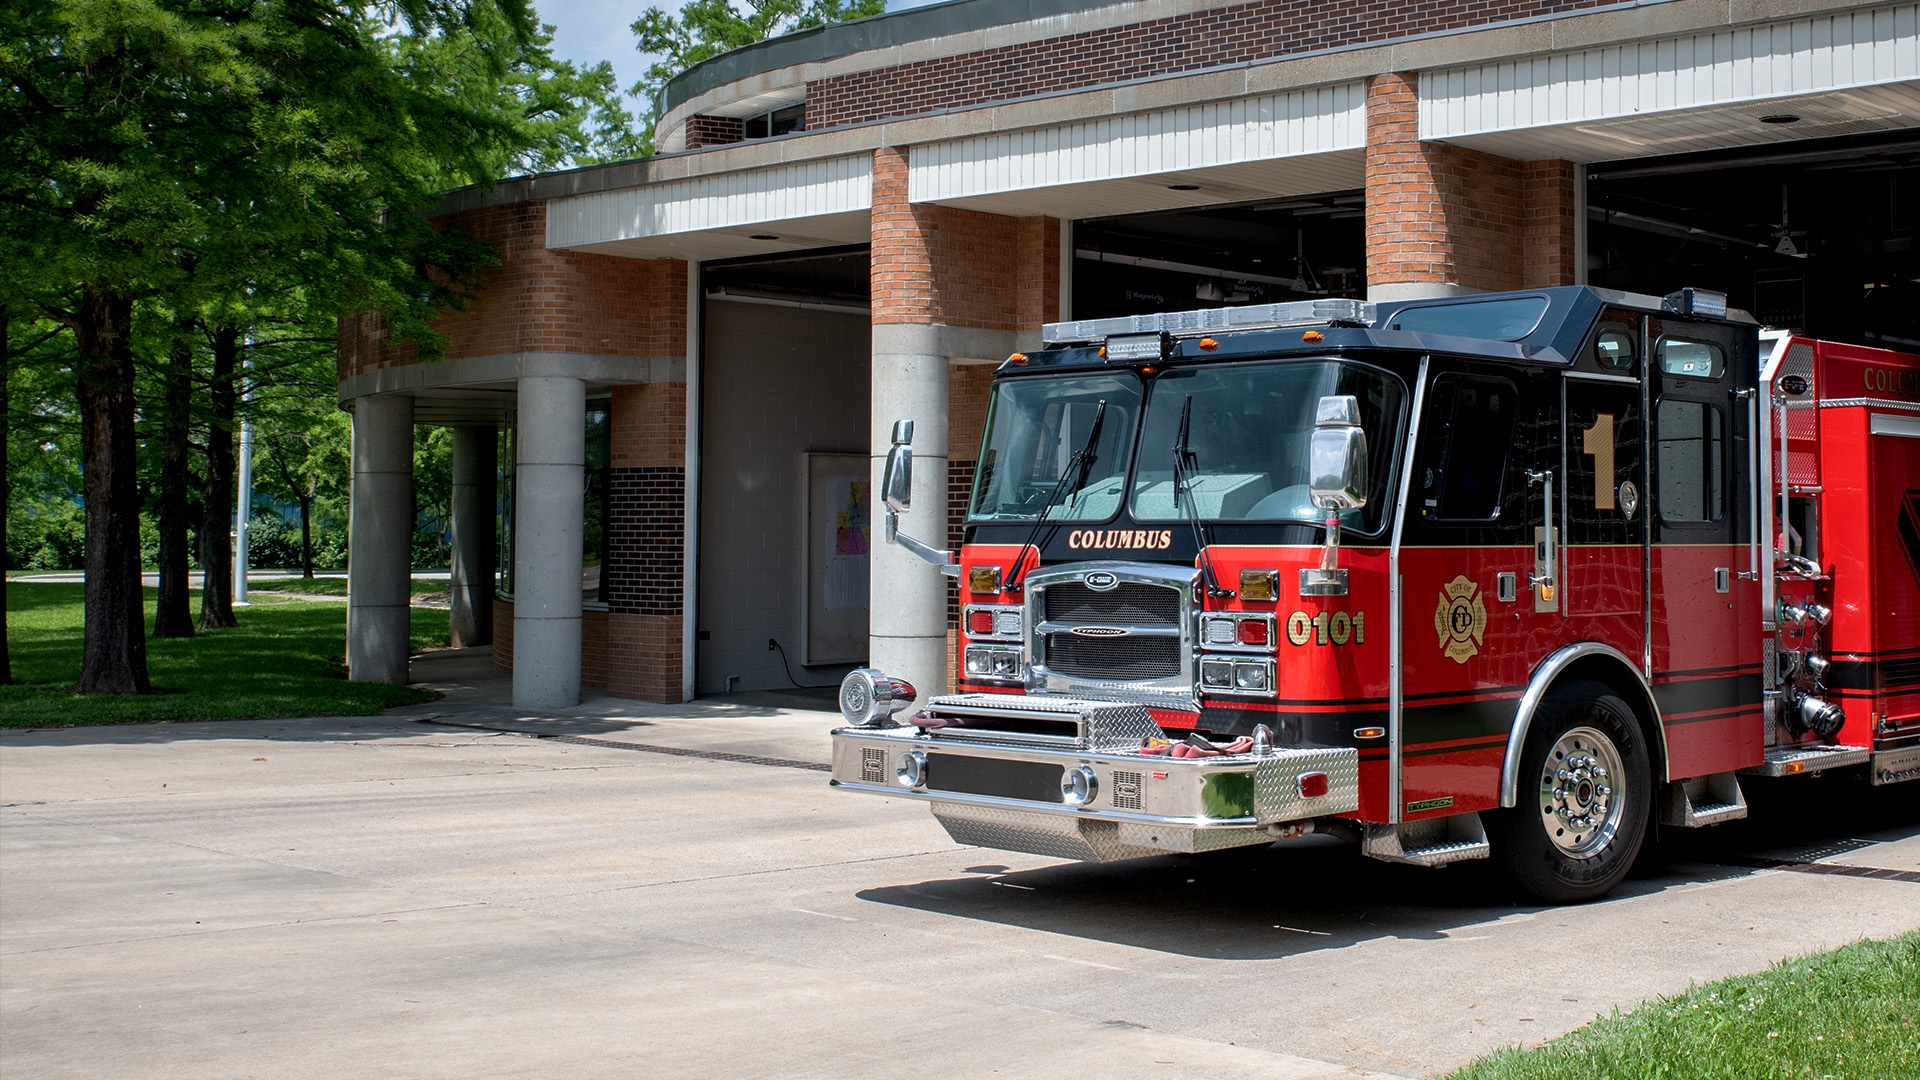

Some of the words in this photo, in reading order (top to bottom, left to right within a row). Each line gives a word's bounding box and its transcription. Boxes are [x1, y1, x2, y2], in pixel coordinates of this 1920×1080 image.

[1583, 414, 1614, 510] 1
[1068, 529, 1172, 549] COLUMBUS
[1450, 583, 1462, 594] CITY
[1287, 611, 1365, 646] 0101
[1449, 645, 1473, 656] COLUMBUS
[1408, 799, 1452, 810] TYPHOON
